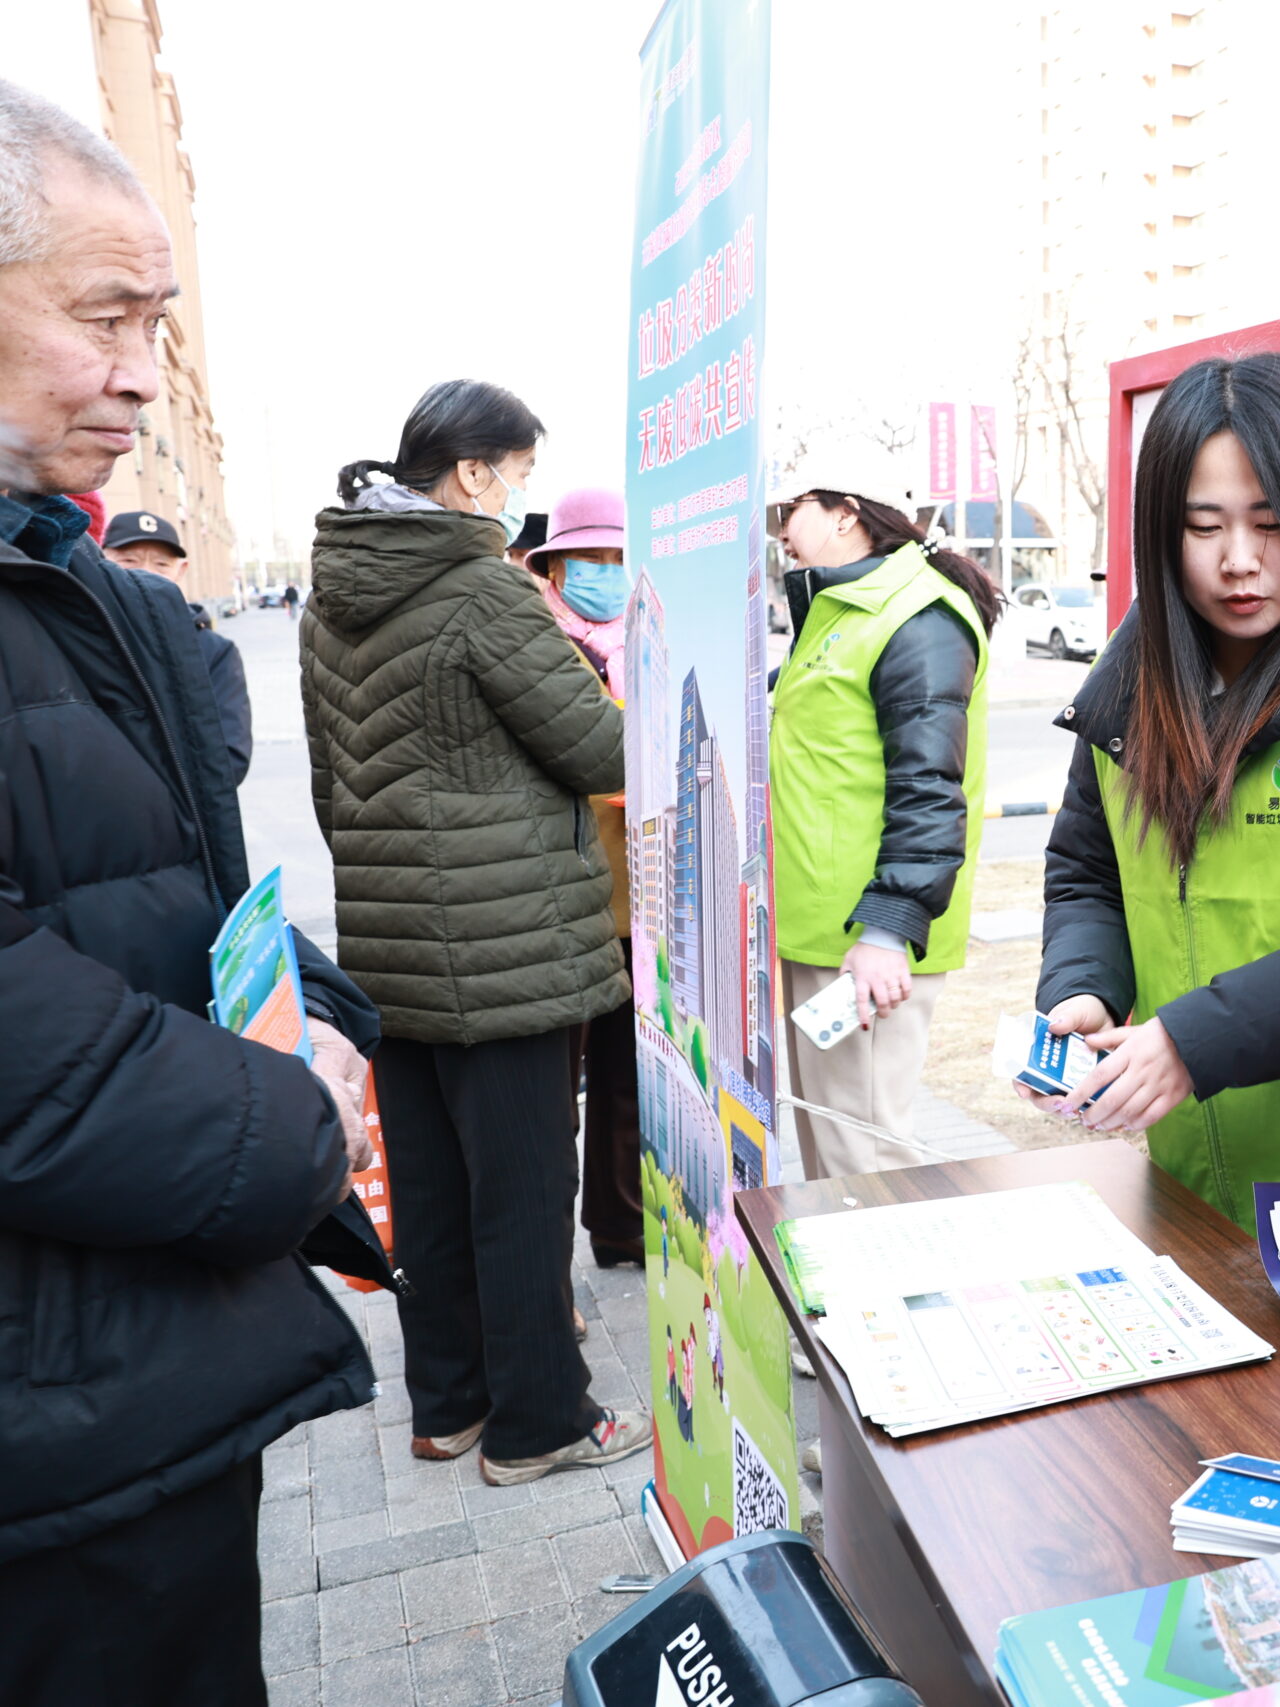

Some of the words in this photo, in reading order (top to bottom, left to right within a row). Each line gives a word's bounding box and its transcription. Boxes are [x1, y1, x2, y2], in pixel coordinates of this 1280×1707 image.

[639, 215, 754, 377] 垃圾分类新时尚
[640, 337, 755, 472] 无废低碳共宣传
[139, 515, 158, 533] C
[666, 1621, 735, 1707] PUSH
